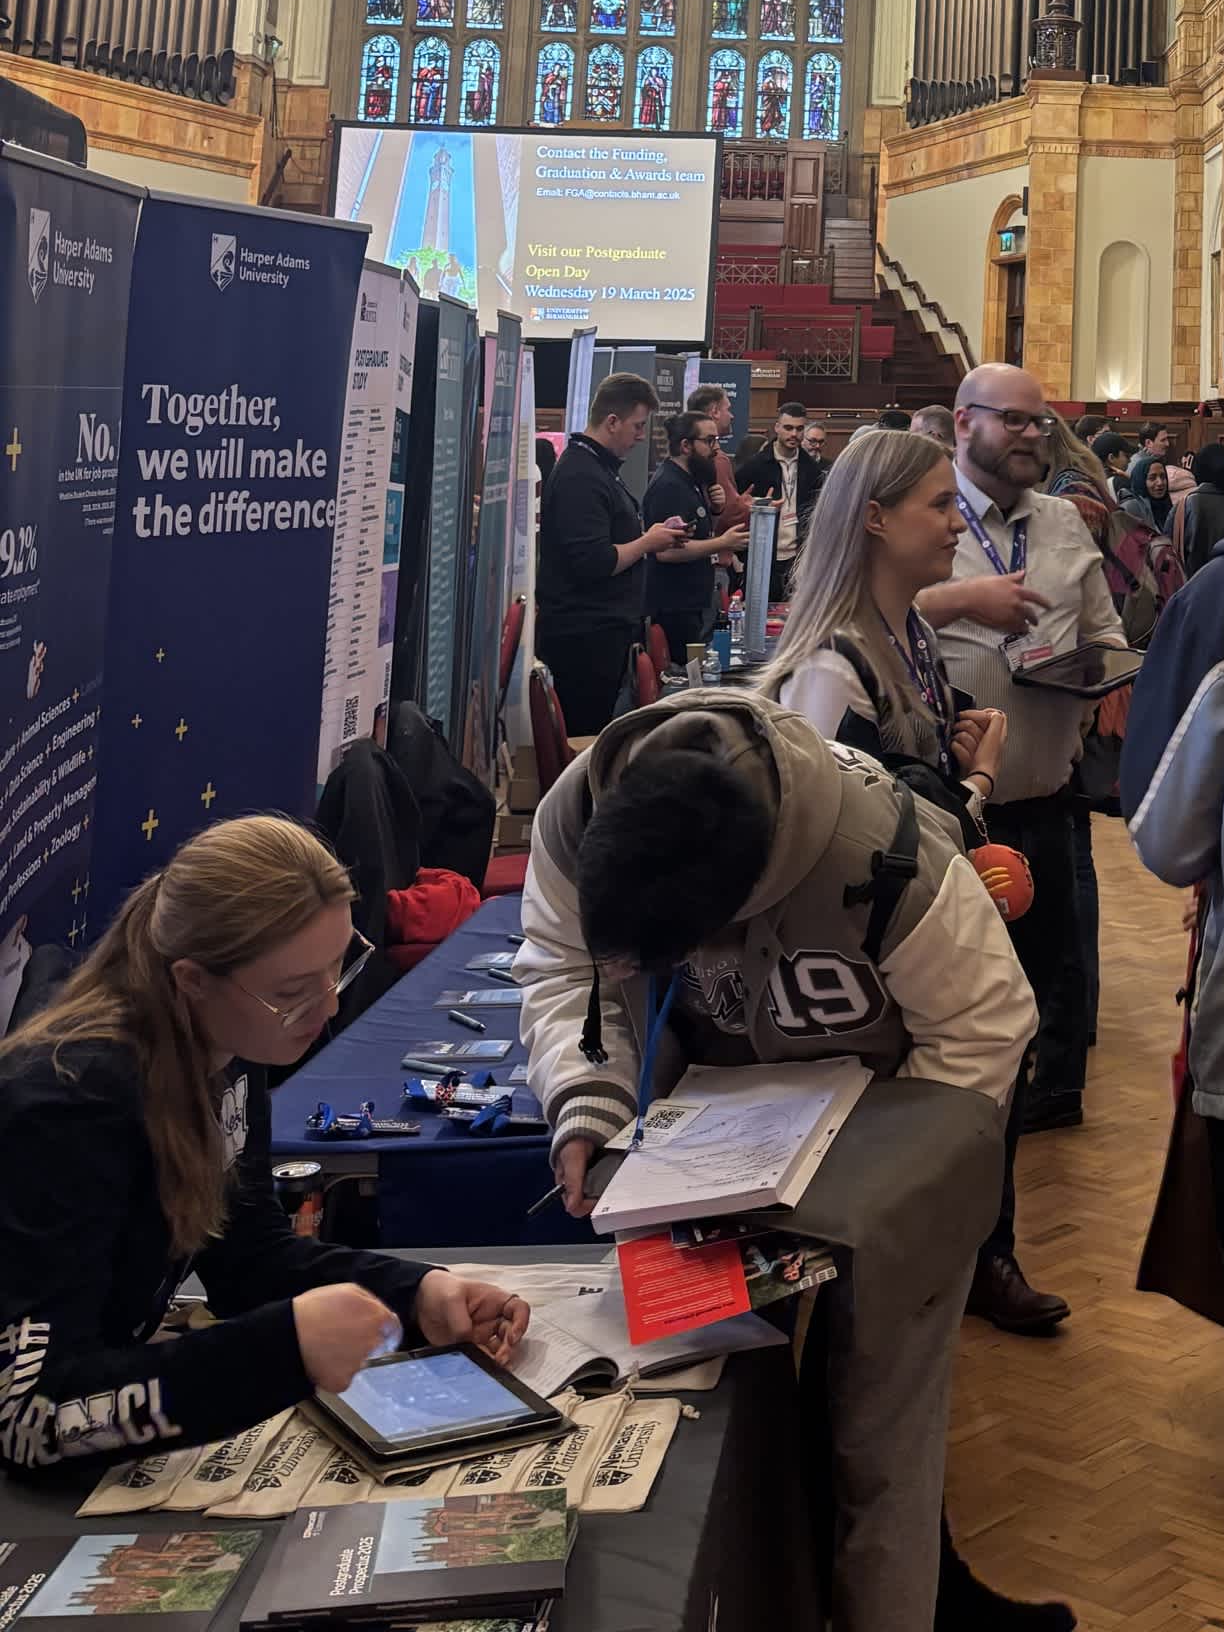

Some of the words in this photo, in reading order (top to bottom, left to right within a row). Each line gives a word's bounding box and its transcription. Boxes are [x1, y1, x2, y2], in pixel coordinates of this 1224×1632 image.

[536, 145, 586, 159] Contact
[589, 147, 608, 159] the
[612, 148, 668, 165] Funding,
[535, 165, 606, 180] Graduation
[609, 167, 623, 180] &
[625, 168, 672, 182] Awards
[675, 169, 705, 182] team
[54, 230, 83, 262] Harper
[84, 237, 113, 264] Adams
[240, 247, 275, 266] Harper
[276, 252, 310, 270] Adams
[527, 244, 557, 257] Visit
[560, 247, 583, 258] our
[585, 245, 667, 261] Postgraduate
[53, 261, 95, 294] University
[239, 266, 290, 289] University
[525, 264, 560, 280] Open
[564, 265, 590, 281] Day
[525, 284, 597, 301] Wednesday
[601, 286, 617, 299] 19
[619, 287, 661, 300] March
[663, 288, 696, 300] 2025
[141, 384, 281, 436] Together,
[137, 448, 189, 481] we
[196, 438, 244, 479] will
[249, 439, 328, 478] make
[132, 494, 192, 538] the
[41, 696, 71, 728] Sciences
[20, 751, 44, 783] Science
[52, 711, 96, 752] Engineering
[11, 775, 51, 825] Sustainability
[57, 749, 87, 781] Wildlife
[33, 802, 63, 840] Property
[7, 853, 42, 902] Professions
[50, 819, 82, 856] Zoology
[768, 952, 880, 1034] 19
[619, 1420, 661, 1469] University
[358, 1536, 374, 1555] 2025
[19, 1573, 46, 1594] 2025
[329, 1549, 354, 1596] Postgraduate
[348, 1555, 370, 1595] Prospectus
